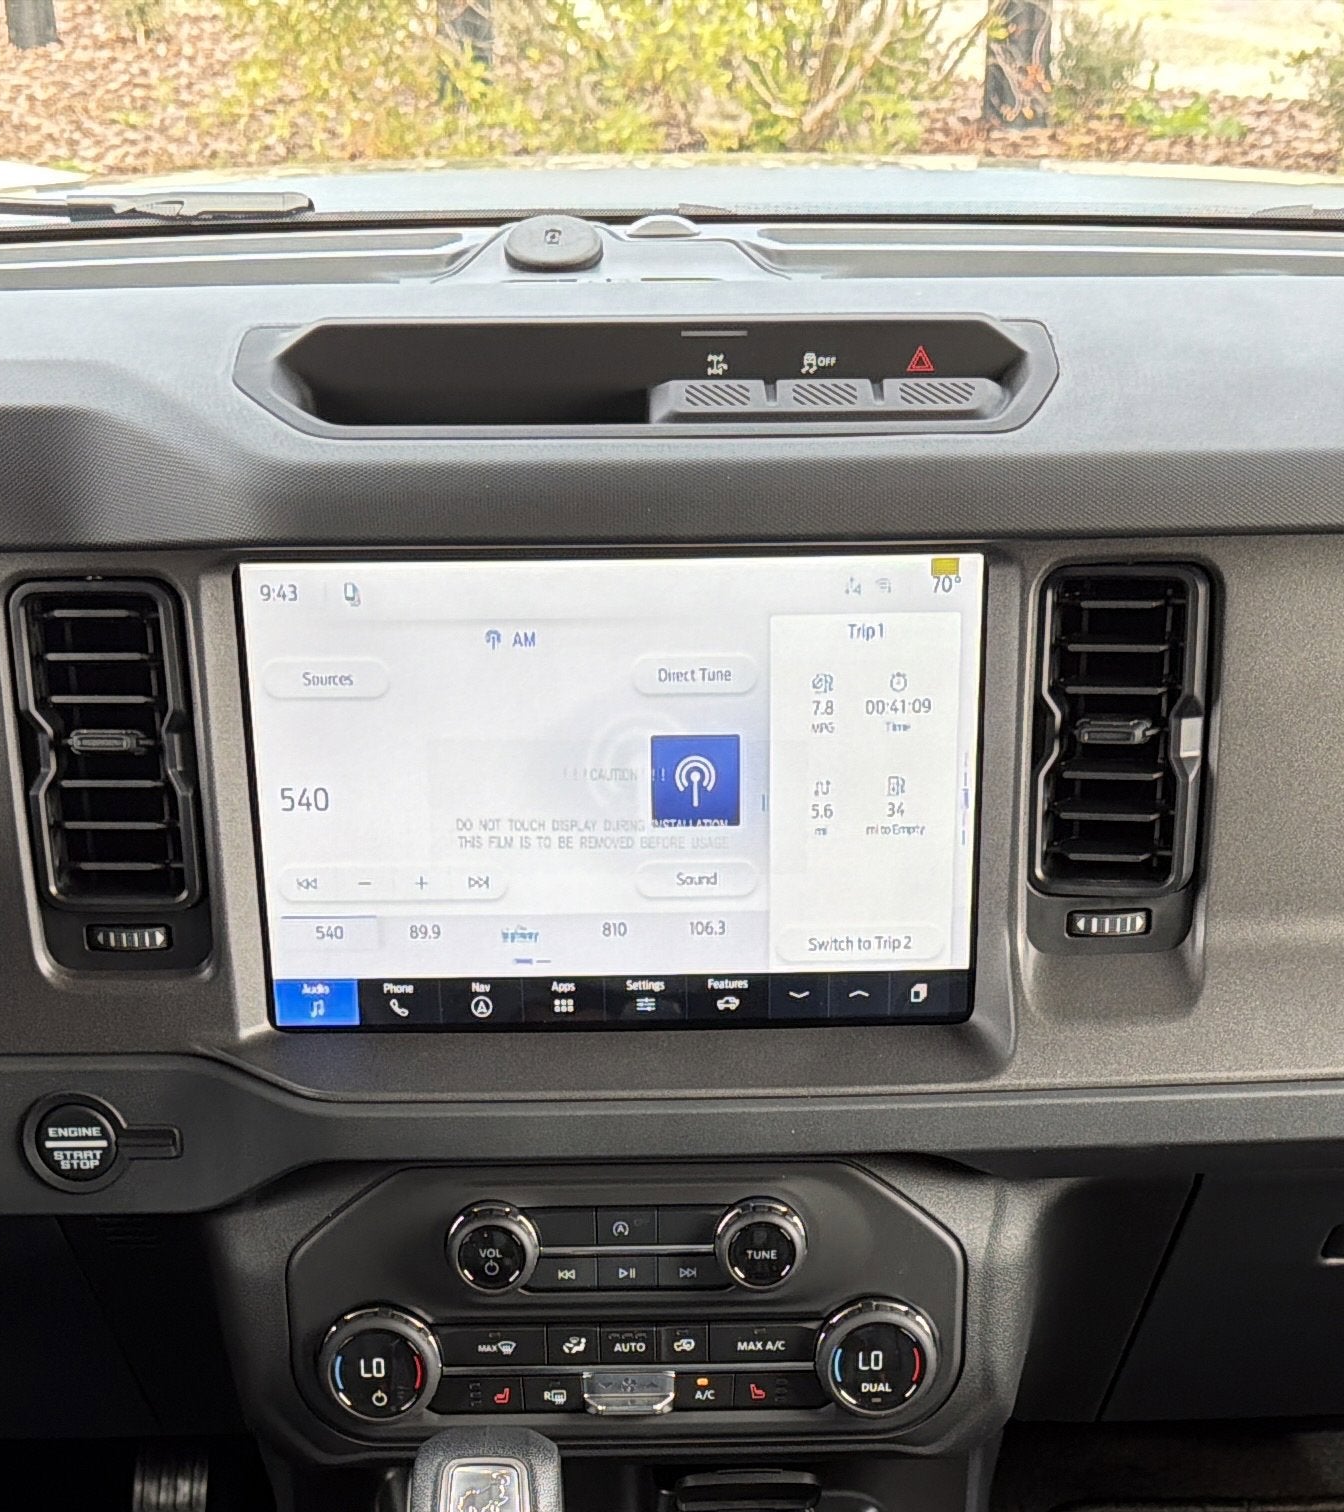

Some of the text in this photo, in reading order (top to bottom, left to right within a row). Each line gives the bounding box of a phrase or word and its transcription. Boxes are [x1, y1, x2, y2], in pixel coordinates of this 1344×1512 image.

[817, 356, 837, 367] OFF
[932, 575, 962, 594] 70°
[259, 583, 298, 602] 9:43
[847, 623, 885, 641] Trip 1
[512, 632, 536, 648] AM
[302, 672, 354, 687] Sources
[657, 667, 732, 682] Direct Tune
[812, 700, 834, 716] 7.8
[864, 698, 932, 716] 00:41:09
[280, 788, 330, 812] 540
[811, 804, 834, 819] 5.6
[887, 802, 905, 817] 34
[456, 818, 473, 832] DO
[479, 818, 502, 832] NOT
[508, 818, 546, 832] TOUCH
[552, 818, 597, 832] DISPLAY
[458, 836, 483, 850] THIS
[488, 836, 513, 850] FILM
[520, 836, 532, 850] IS
[536, 836, 552, 850] TO
[558, 836, 573, 850] BE
[580, 836, 634, 850] REMOVED
[676, 872, 718, 886] Sound
[316, 925, 344, 940] 540
[409, 924, 442, 940] 89.9
[602, 922, 628, 937] 810
[689, 921, 726, 936] 106.3
[808, 936, 912, 952] Switch to Trip 2
[301, 982, 330, 995] Audio
[383, 982, 414, 995] Phone
[471, 981, 491, 993] Nav
[551, 981, 576, 993] Apps
[626, 979, 665, 992] Settings
[707, 978, 749, 990] Features
[47, 1127, 102, 1138] ENGINE
[53, 1150, 103, 1161] START
[60, 1160, 100, 1170] STOP
[479, 1248, 503, 1259] VOL
[746, 1249, 778, 1260] TUNE
[477, 1344, 498, 1353] MAX
[614, 1342, 646, 1353] AUTO
[737, 1340, 786, 1352] MAX A/C
[359, 1357, 385, 1378] LO
[858, 1350, 883, 1371] LO
[695, 1389, 716, 1400] A/C
[861, 1382, 892, 1393] DUAL
